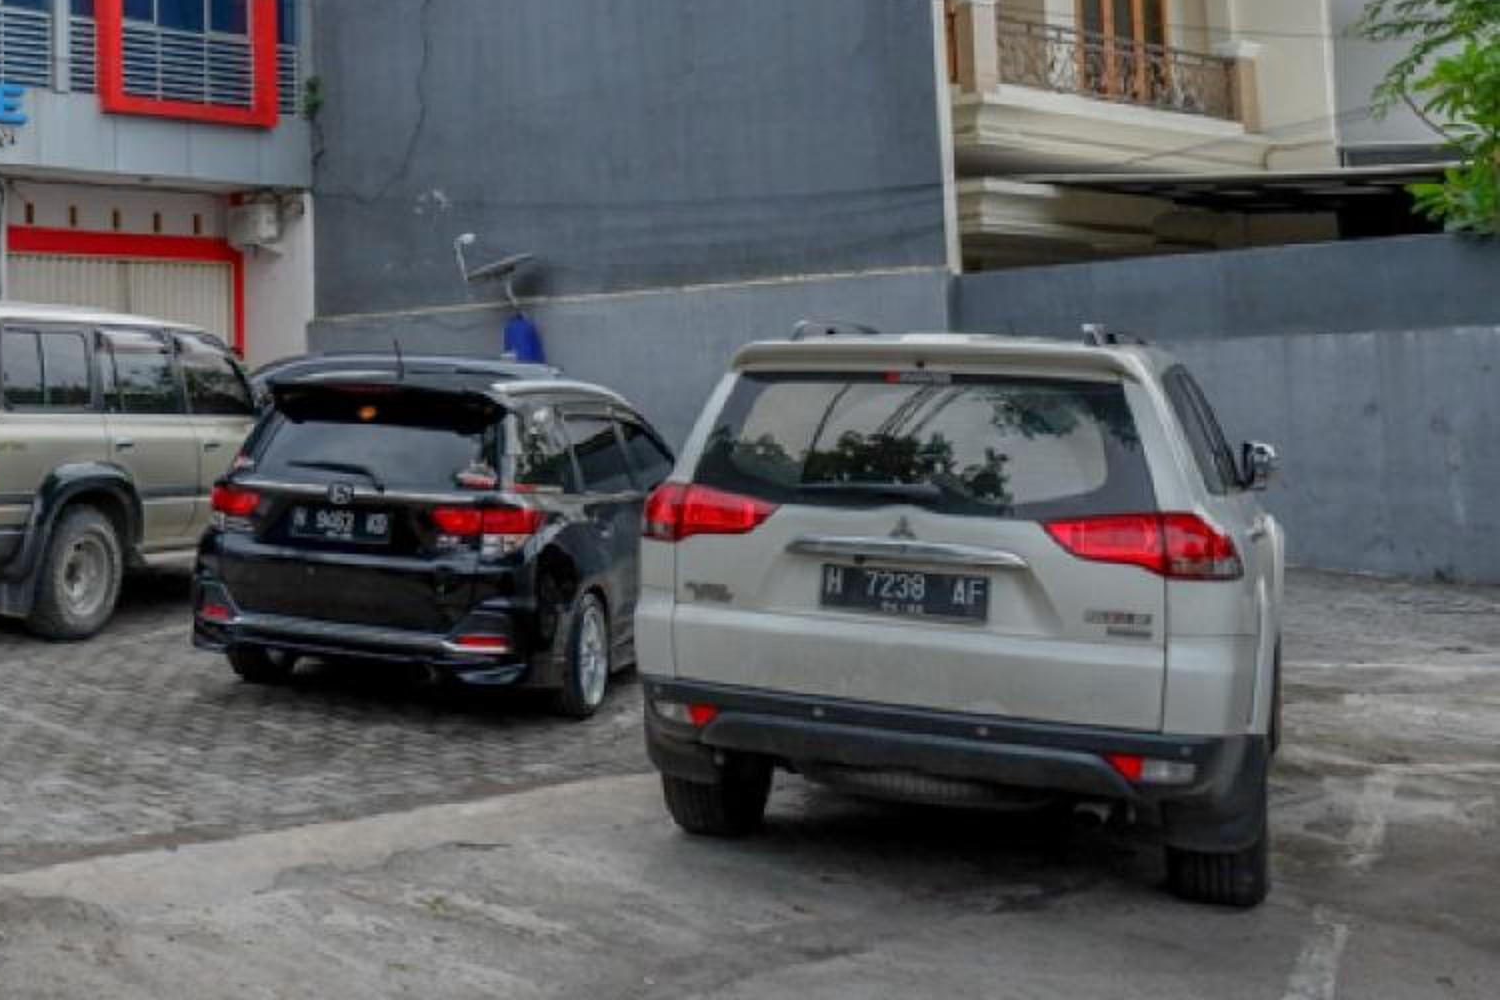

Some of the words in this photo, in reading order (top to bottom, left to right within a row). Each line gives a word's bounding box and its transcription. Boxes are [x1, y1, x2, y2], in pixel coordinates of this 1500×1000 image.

[826, 567, 843, 595] H
[867, 570, 926, 600] 7238
[953, 576, 985, 605] AF
